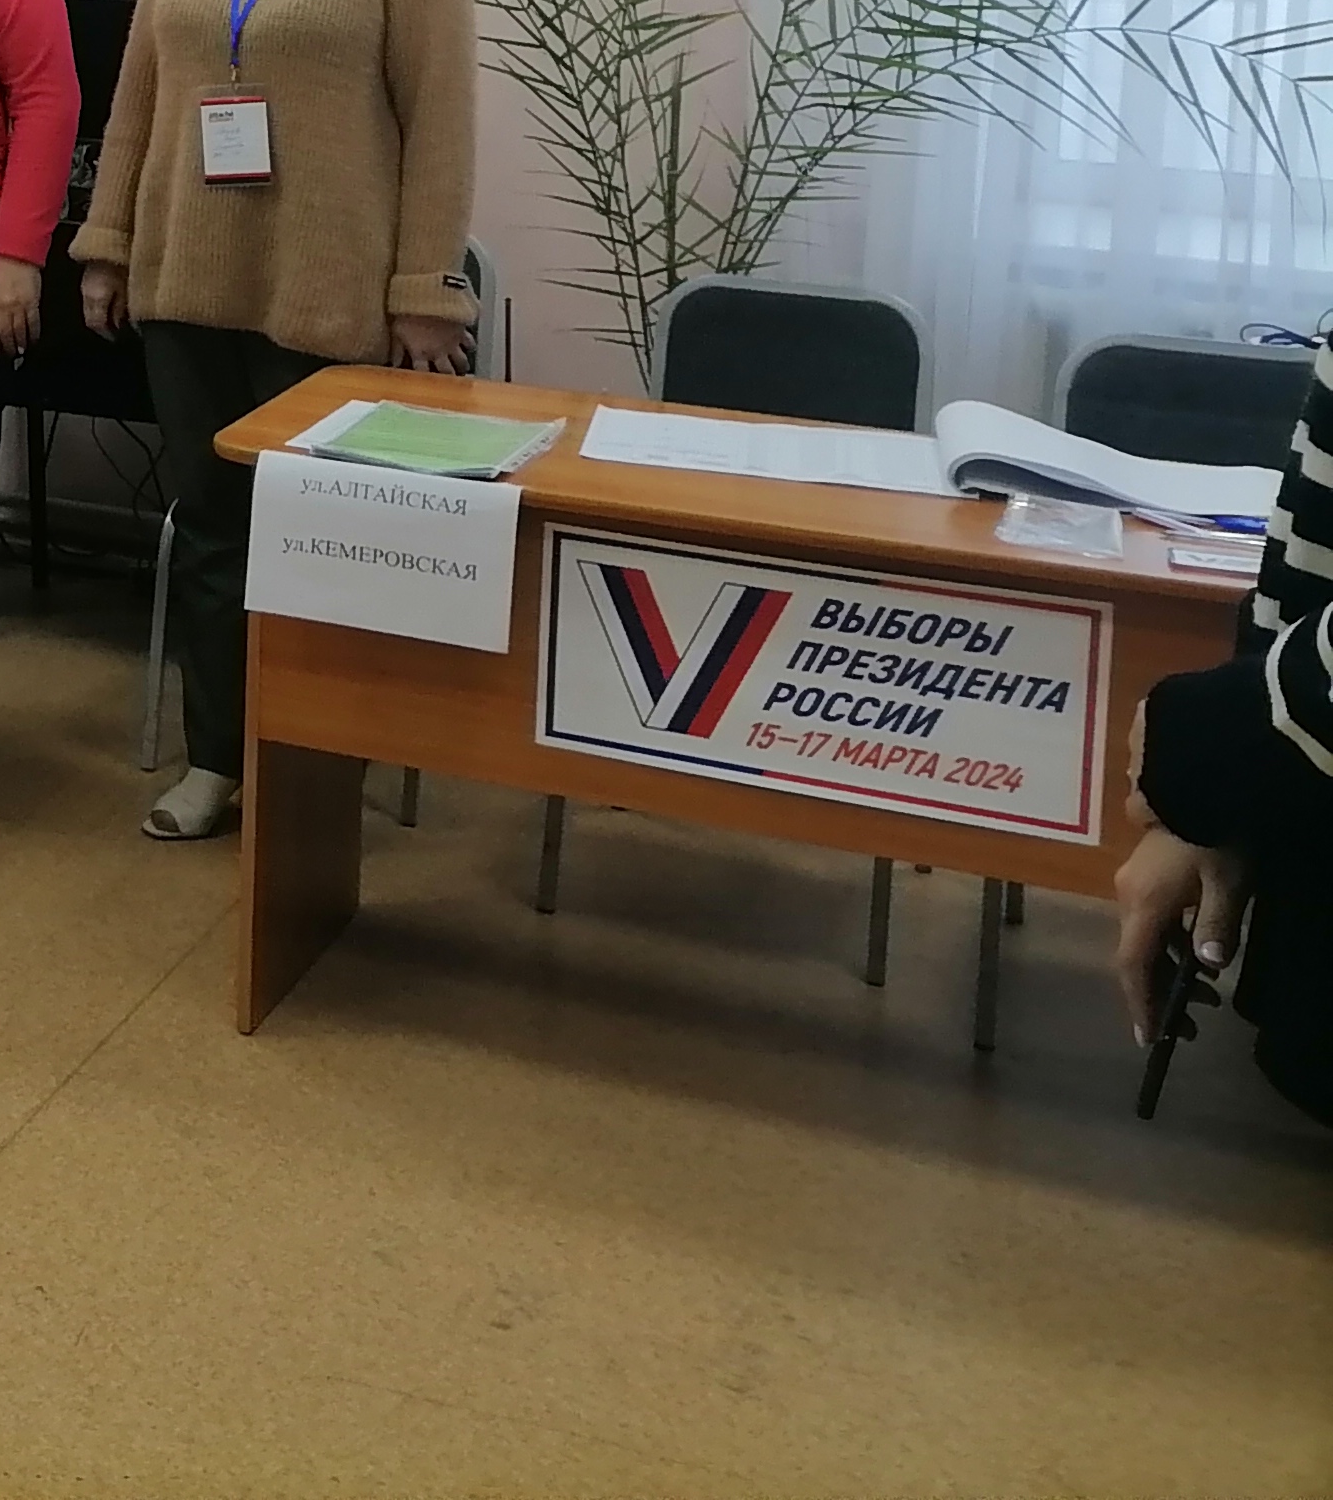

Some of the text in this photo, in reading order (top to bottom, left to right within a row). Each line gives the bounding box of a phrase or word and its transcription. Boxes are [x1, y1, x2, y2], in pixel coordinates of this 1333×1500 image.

[300, 476, 468, 517] ул.АЛТАЙСКАЯ
[282, 537, 478, 582] ул.КЕМЕРОВСКАЯ
[810, 597, 1014, 657] ВЫБОРЫ
[786, 640, 1073, 714] ПРЕЗИДЕНТА
[762, 682, 945, 739] РОССИИ
[831, 736, 938, 780] МАРТА
[942, 756, 1026, 795] 2024
